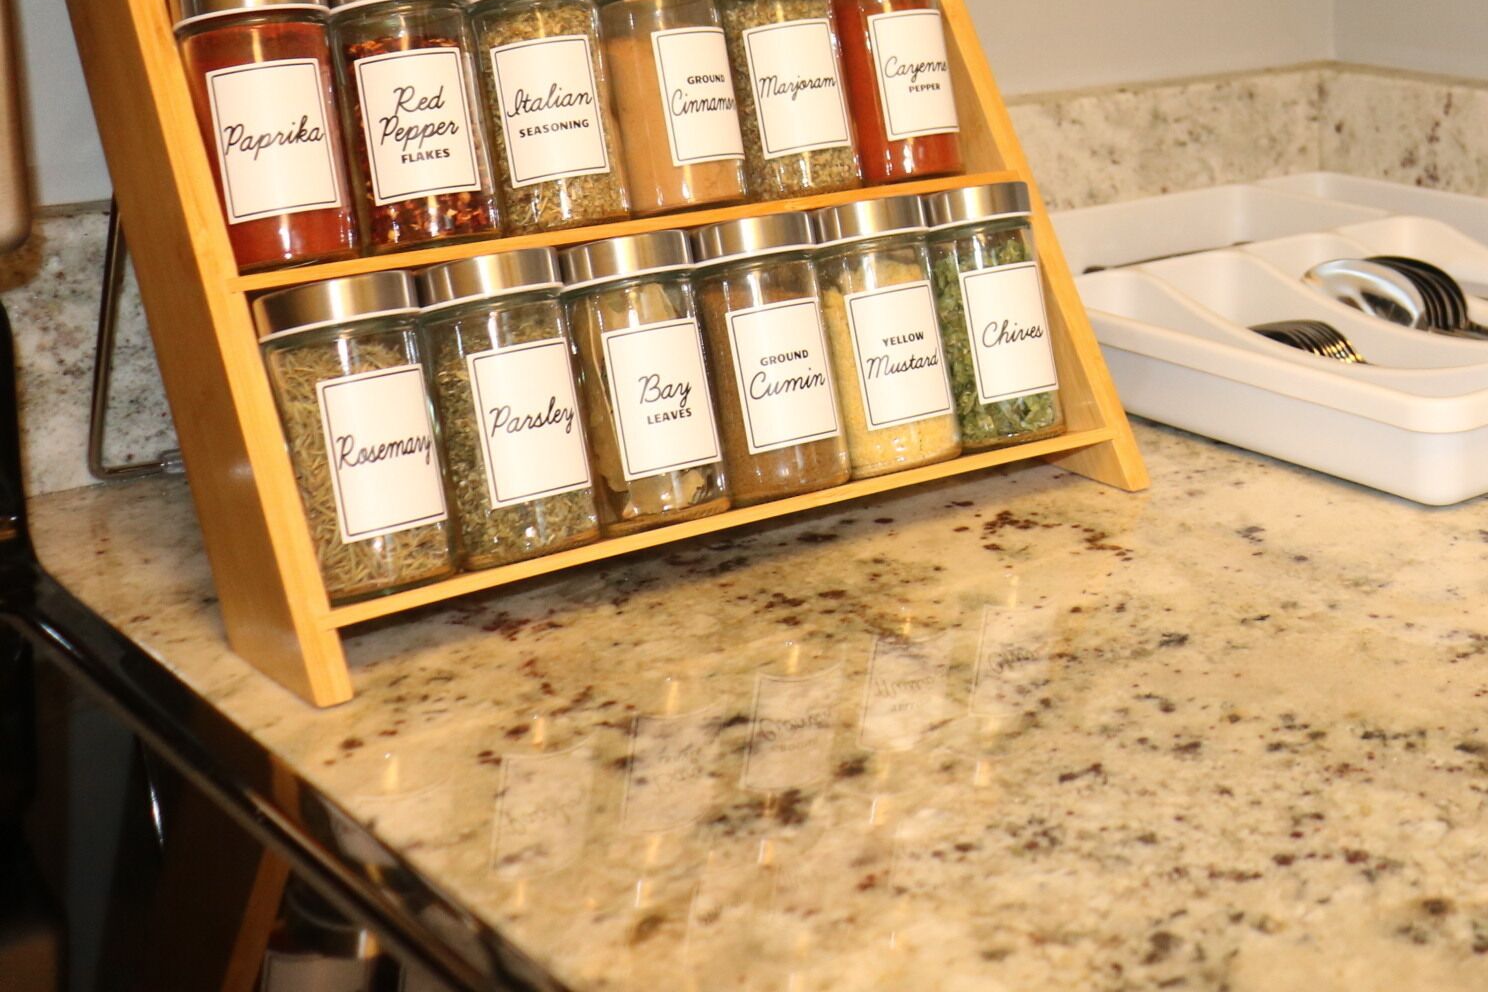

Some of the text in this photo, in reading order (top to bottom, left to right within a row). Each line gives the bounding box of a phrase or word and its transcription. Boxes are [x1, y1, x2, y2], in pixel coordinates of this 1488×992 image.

[687, 74, 726, 85] GROUND
[759, 74, 836, 101] Marjoram
[909, 83, 941, 93] PEPPER
[393, 85, 446, 115] Red
[507, 82, 593, 117] Italian
[223, 116, 324, 161] Paprika
[379, 115, 460, 152] Pepper
[519, 119, 590, 139] SEASONING
[401, 149, 451, 164] FLAKES
[882, 331, 925, 347] YELLOW
[981, 320, 1044, 349] Chives
[759, 349, 809, 367] GROUND
[866, 349, 939, 380] Mustard
[638, 373, 692, 409] Bay
[748, 368, 826, 401] Cumin
[489, 396, 575, 438] Parsley
[647, 408, 692, 425] LEAVES
[336, 432, 433, 472] Rosemary
